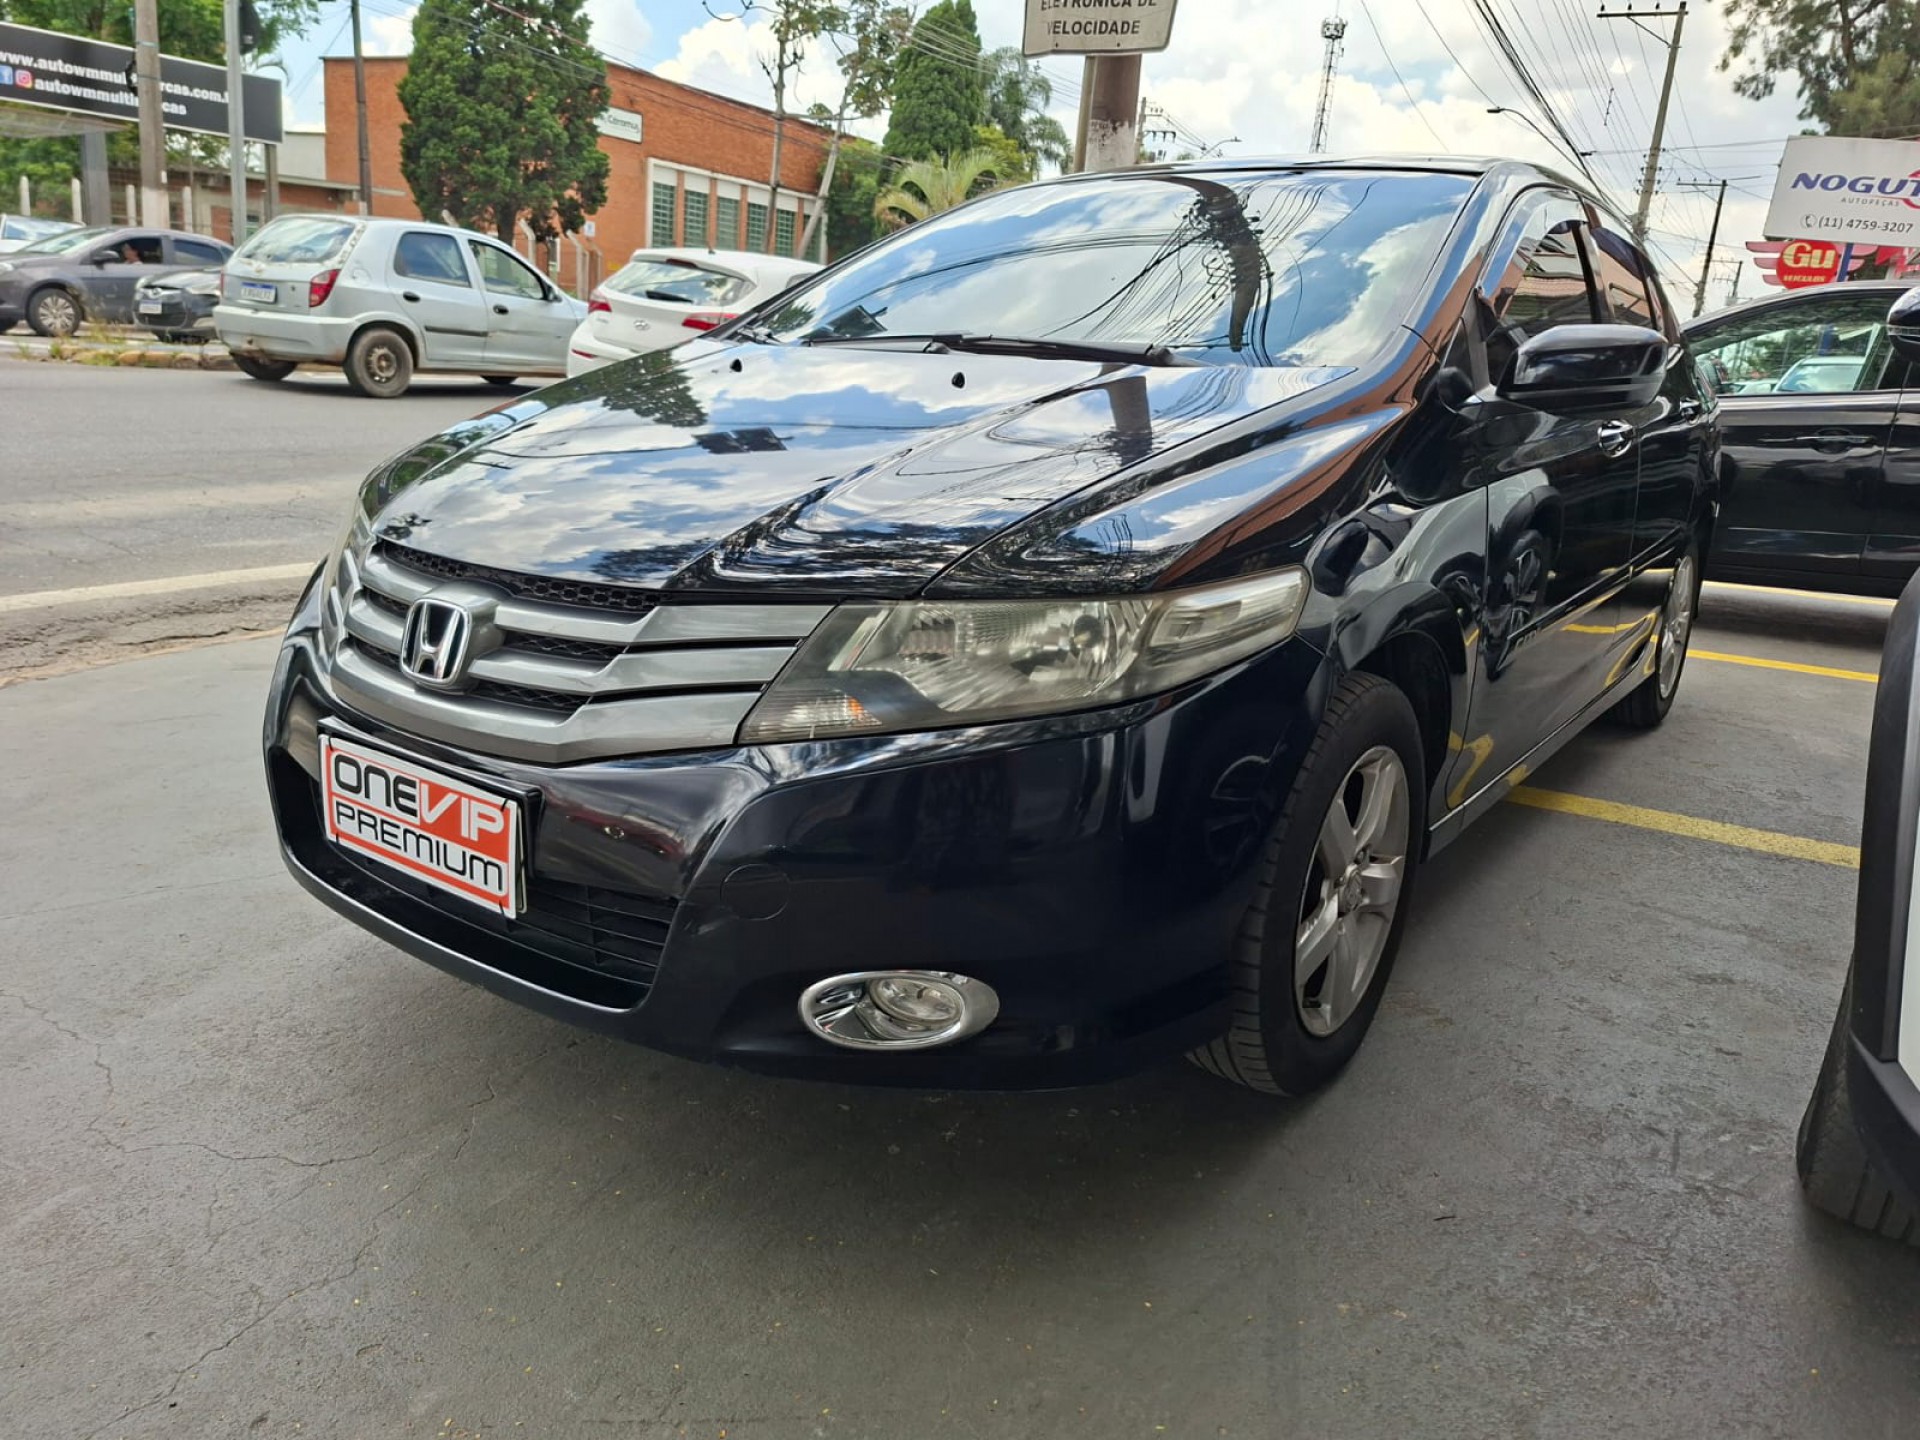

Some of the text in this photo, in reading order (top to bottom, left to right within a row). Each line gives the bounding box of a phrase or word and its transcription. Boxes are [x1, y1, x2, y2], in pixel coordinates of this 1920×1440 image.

[1047, 20, 1140, 35] VELOCIDADE
[1818, 216, 1914, 233] (11) 4759-3207
[1782, 242, 1836, 269] Gu
[335, 800, 503, 892] PREMIUM
